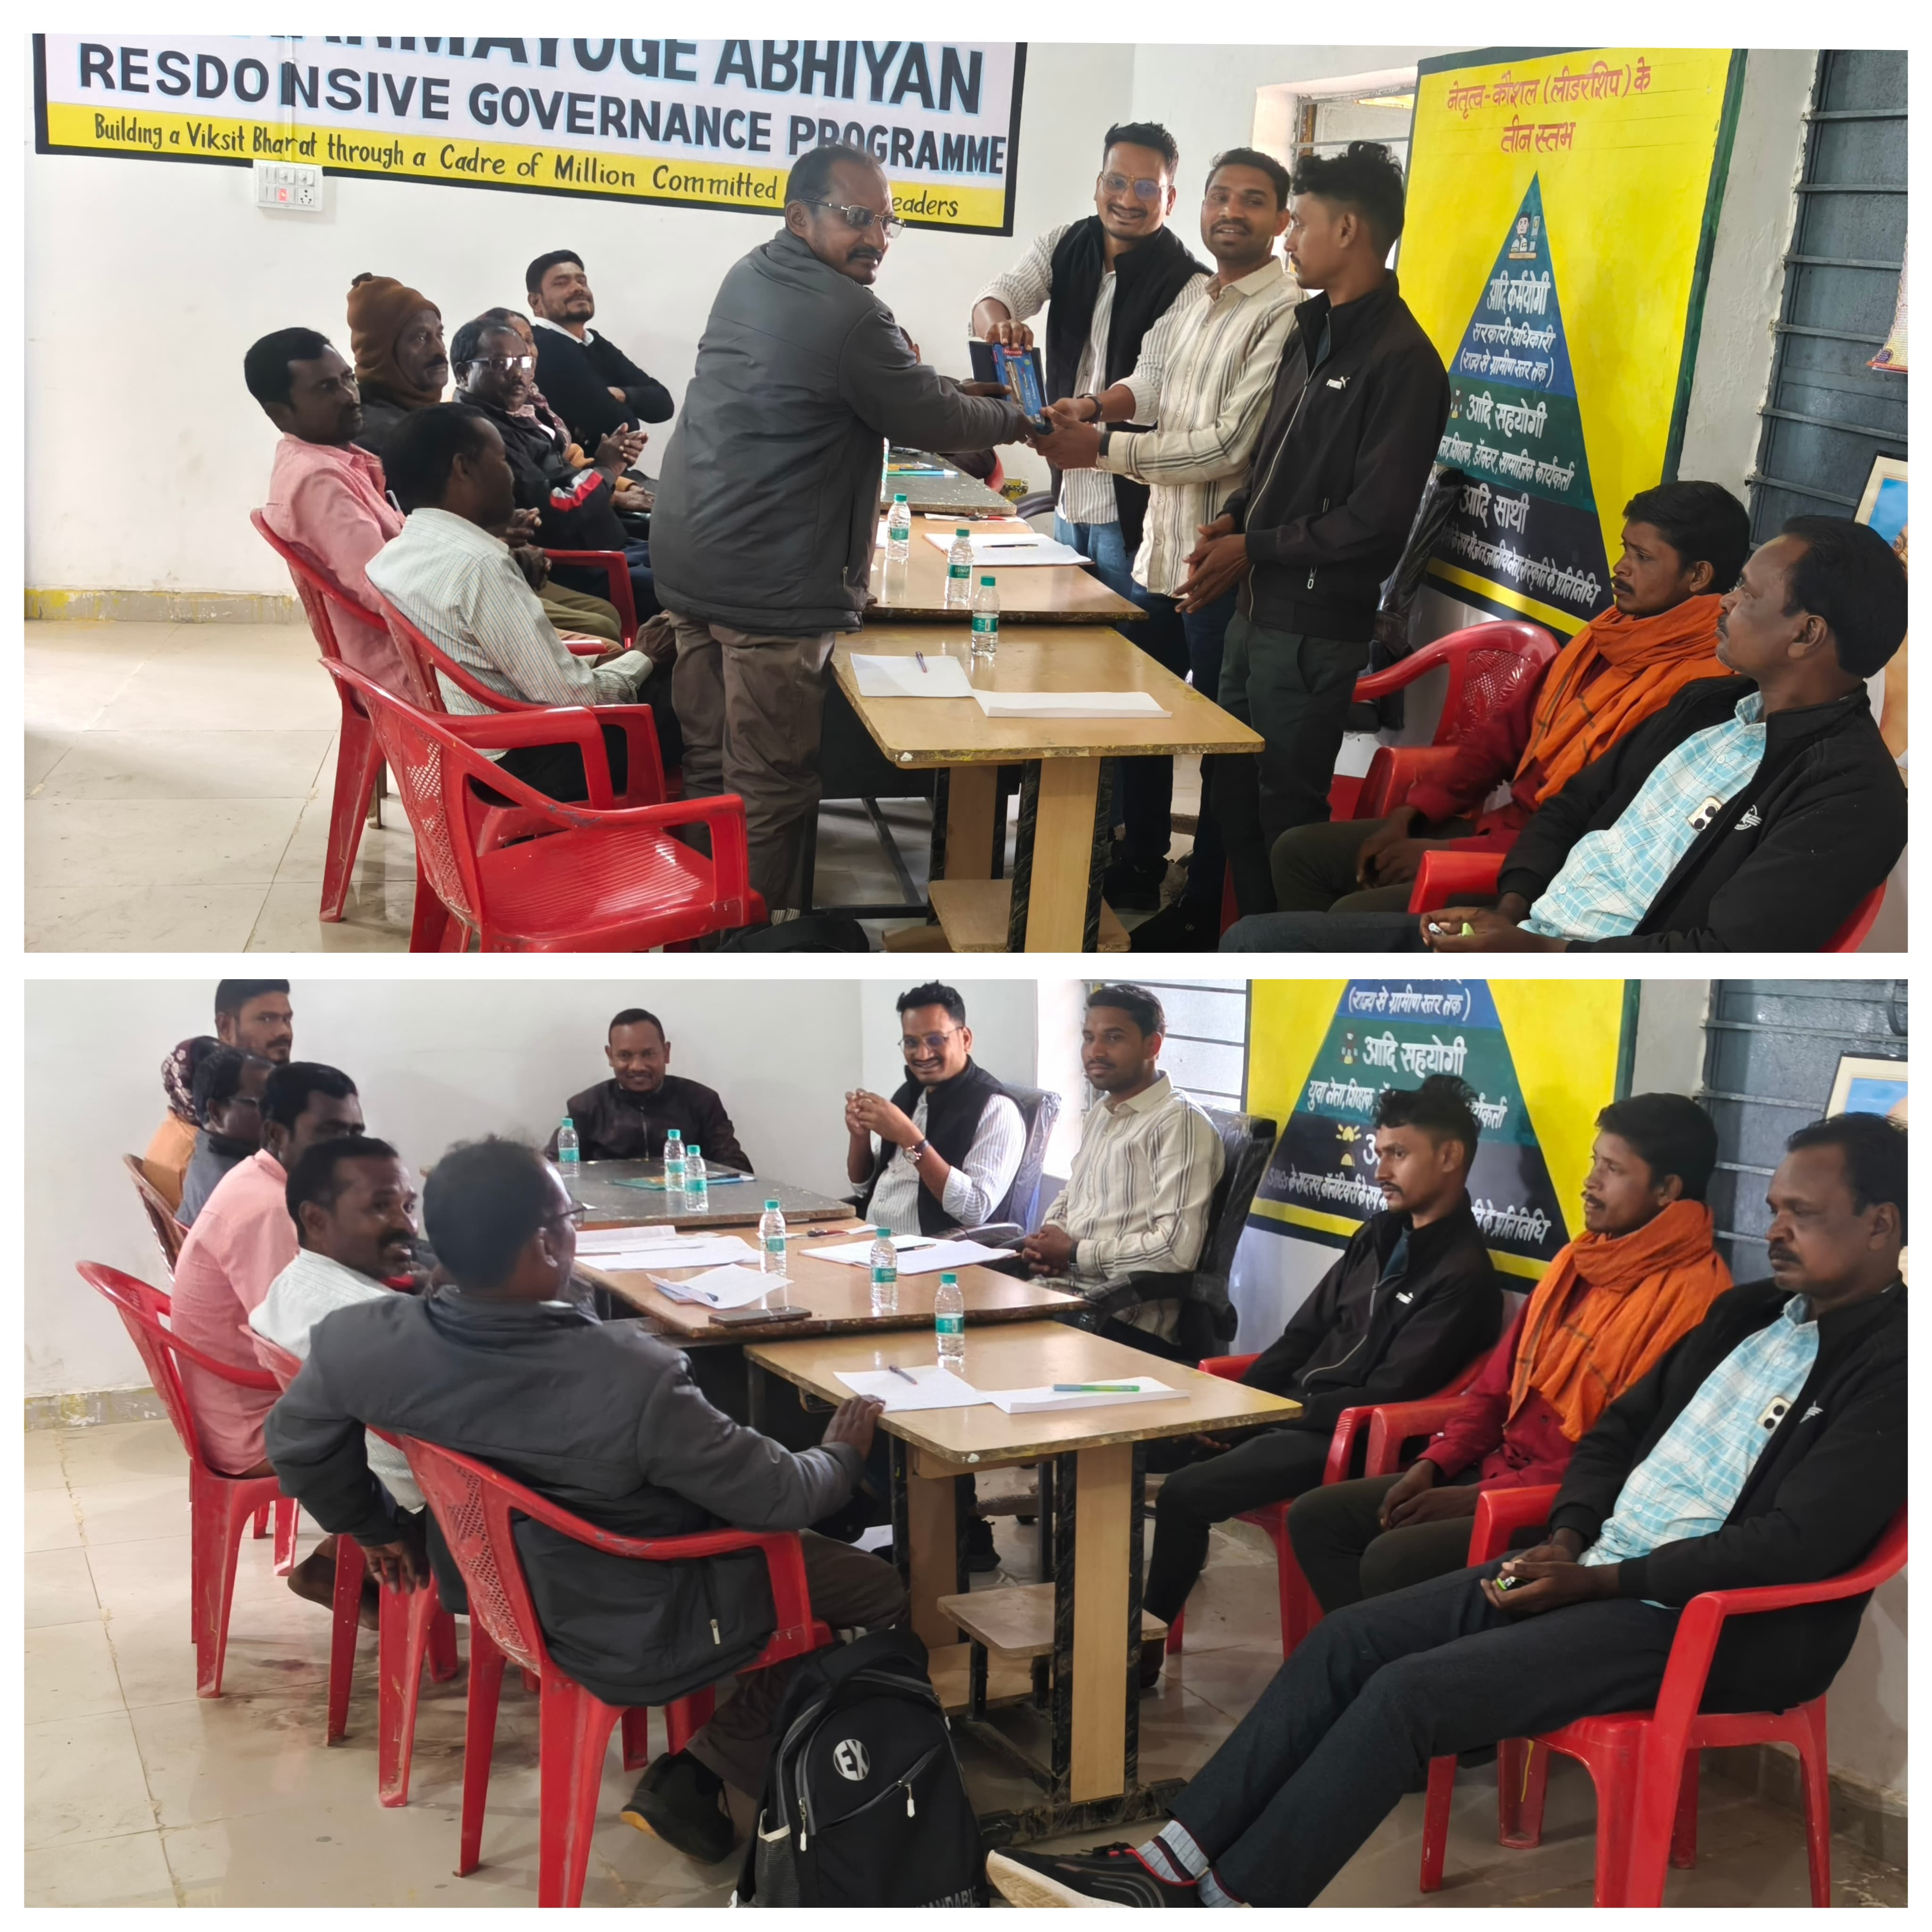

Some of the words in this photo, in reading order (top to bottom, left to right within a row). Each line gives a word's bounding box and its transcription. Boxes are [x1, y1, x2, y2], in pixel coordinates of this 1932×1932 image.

[1634, 56, 1651, 93] के
[469, 83, 772, 152] GOVERNANCE
[788, 115, 1007, 174] PROGRAMME
[94, 113, 162, 150] Building
[170, 130, 180, 145] a
[186, 121, 245, 152] Viksit
[328, 133, 403, 169] through
[413, 152, 426, 166] a
[440, 144, 506, 175] Cadre
[517, 152, 543, 178] of
[554, 154, 635, 187] Million
[652, 165, 778, 200] Committed
[891, 190, 958, 217] eaders
[1473, 317, 1514, 345] सरकारी
[1466, 390, 1494, 431] आदि
[1495, 398, 1548, 439] सहयोगी
[1494, 493, 1530, 535] साथी
[1362, 1031, 1398, 1073] आदि
[1400, 1034, 1468, 1079] सहयोगी
